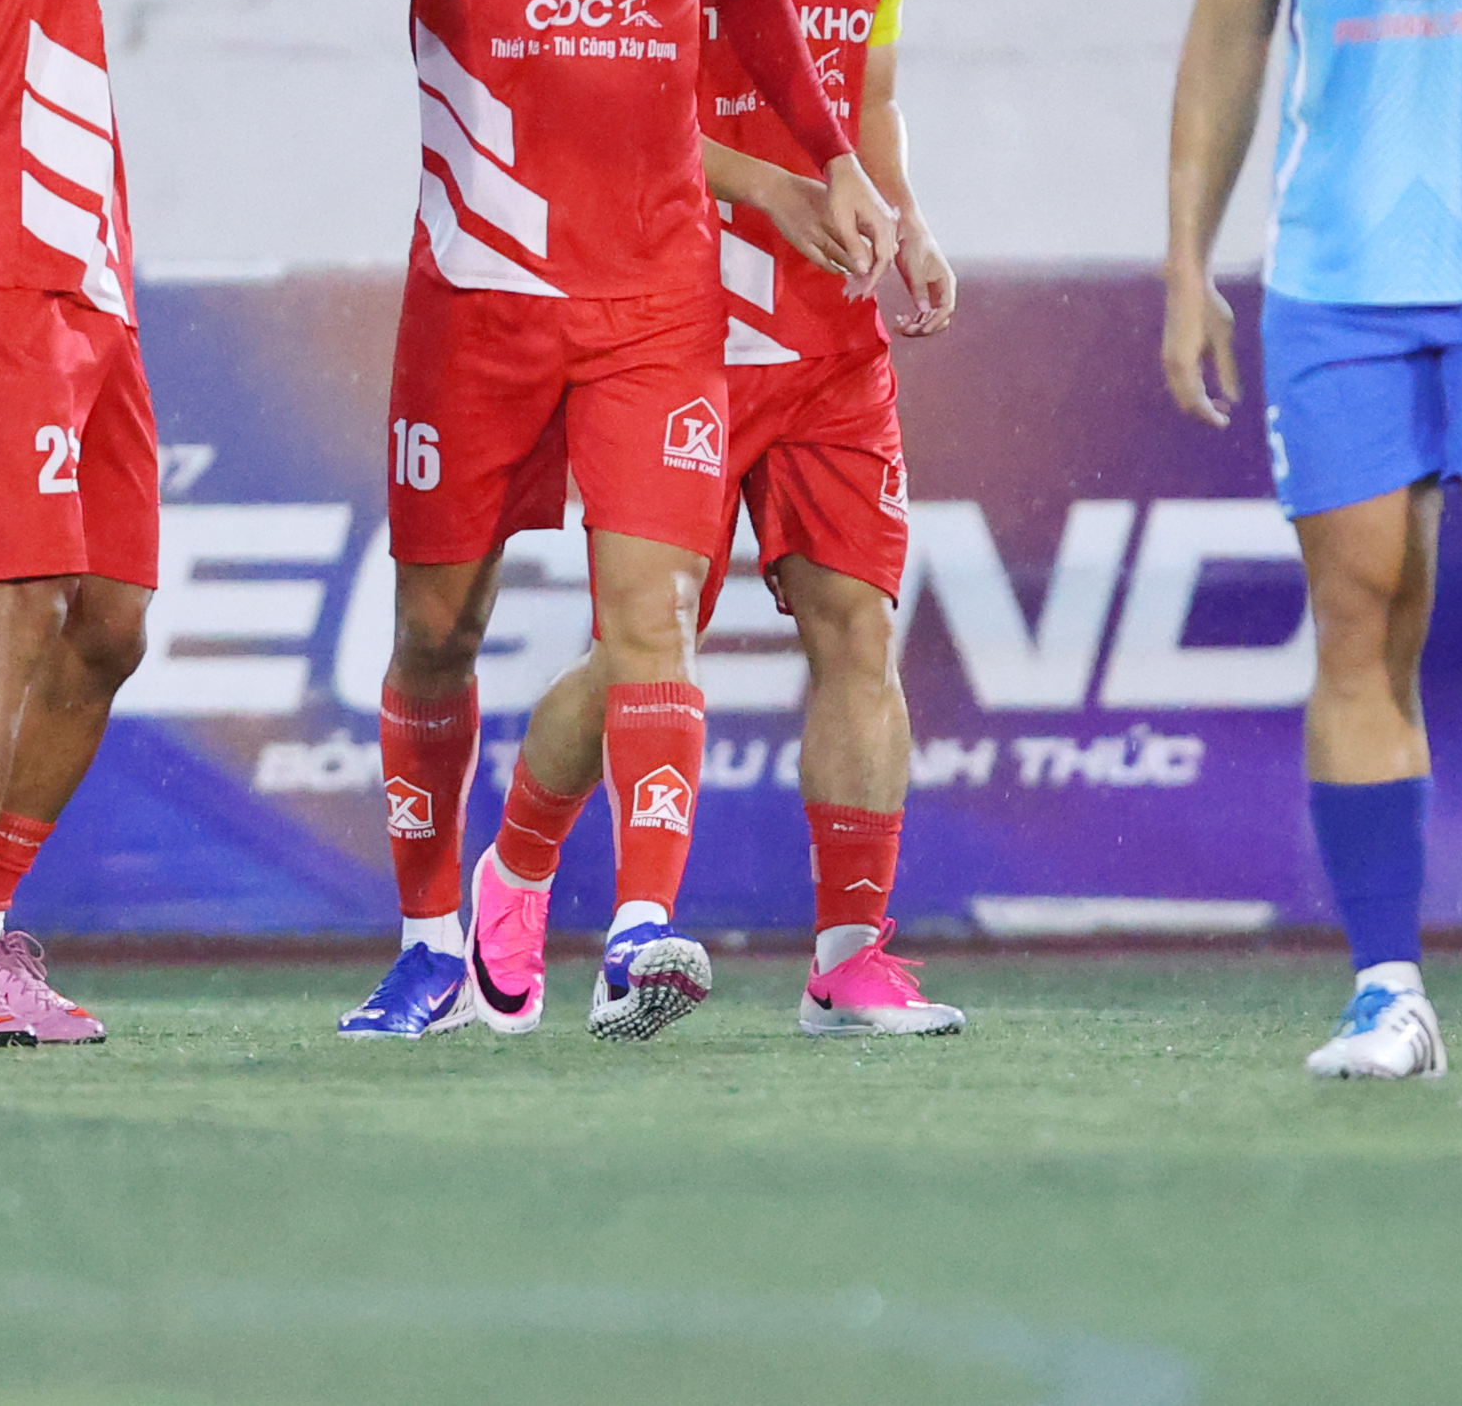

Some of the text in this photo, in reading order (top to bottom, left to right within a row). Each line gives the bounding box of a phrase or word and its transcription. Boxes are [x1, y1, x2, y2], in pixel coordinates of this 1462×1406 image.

[553, 36, 576, 56] Thi
[579, 36, 616, 59] Công
[619, 36, 645, 60] Xây
[393, 417, 441, 491] 16
